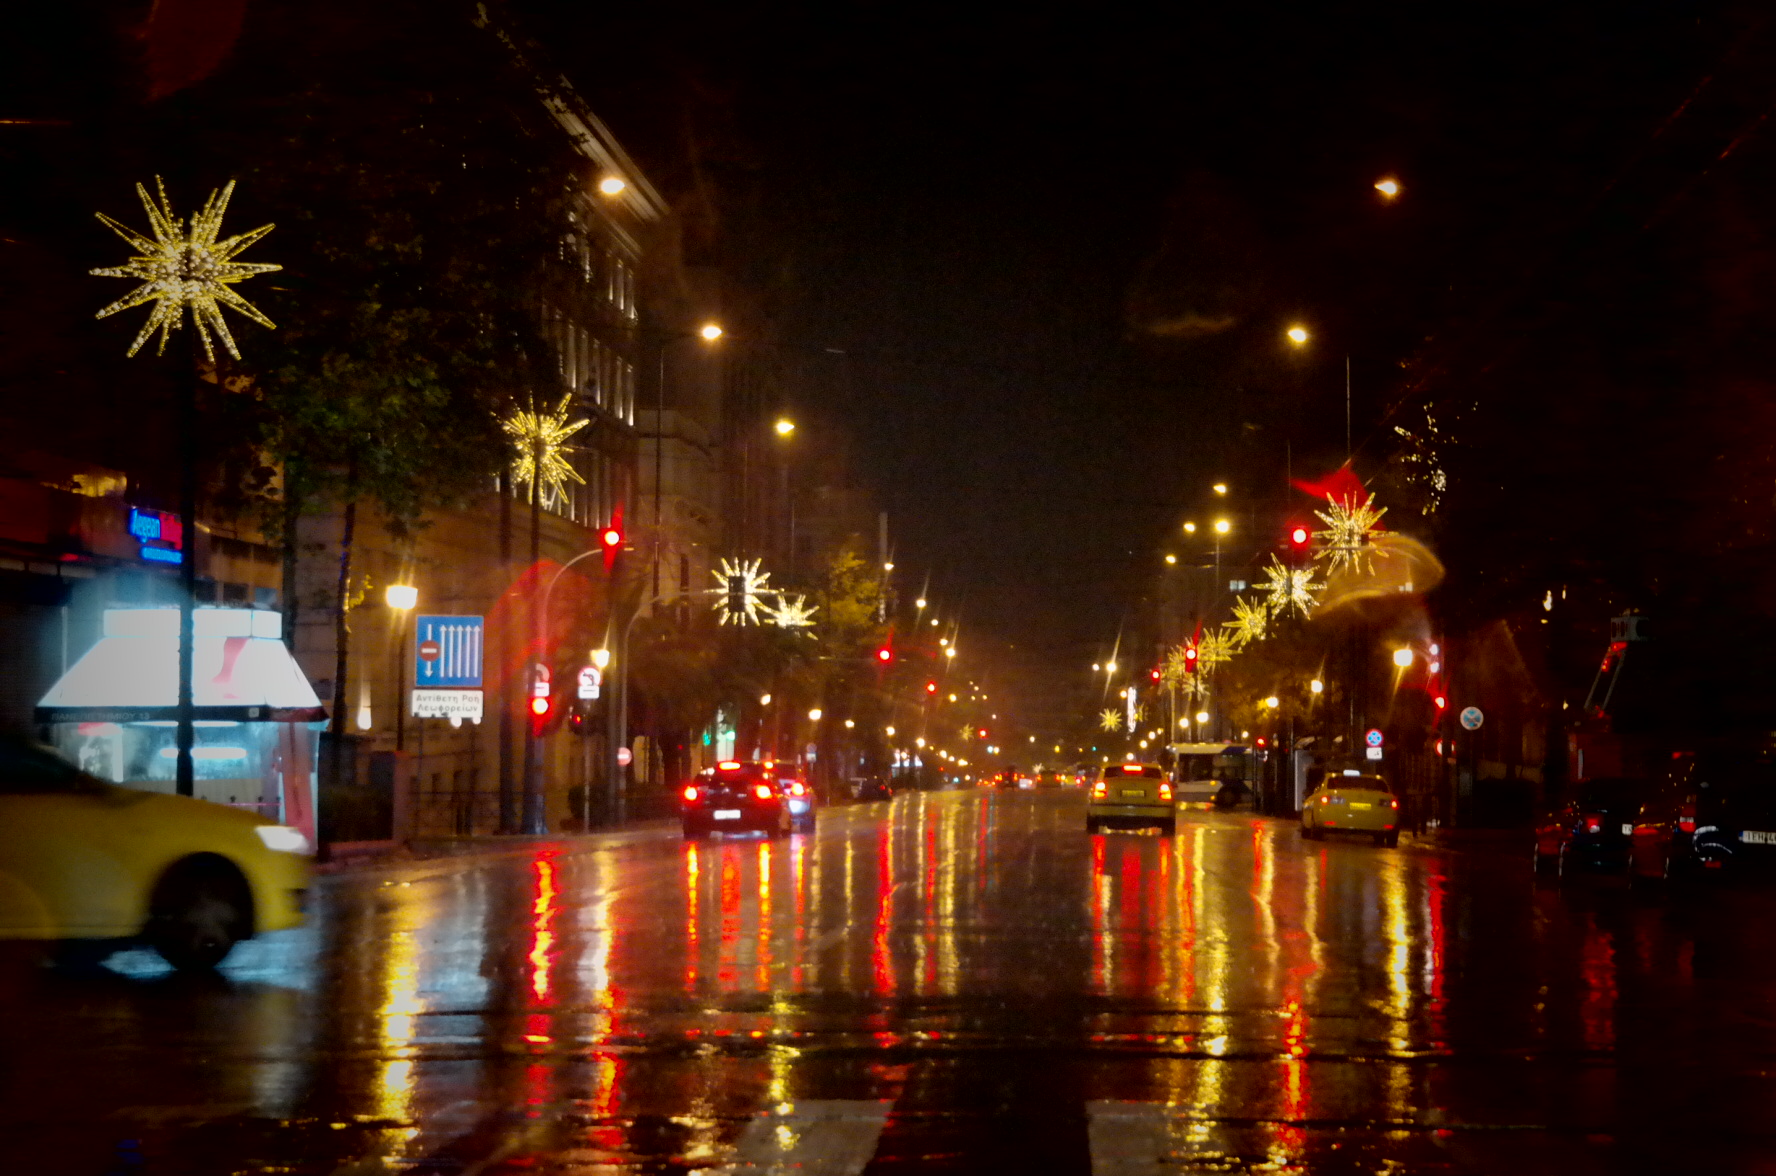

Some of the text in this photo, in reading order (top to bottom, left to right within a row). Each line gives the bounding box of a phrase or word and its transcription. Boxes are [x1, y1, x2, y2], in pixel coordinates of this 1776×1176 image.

[417, 695, 480, 704] Αντίθετη Ροή
[418, 704, 478, 713] Λεωφορείων
